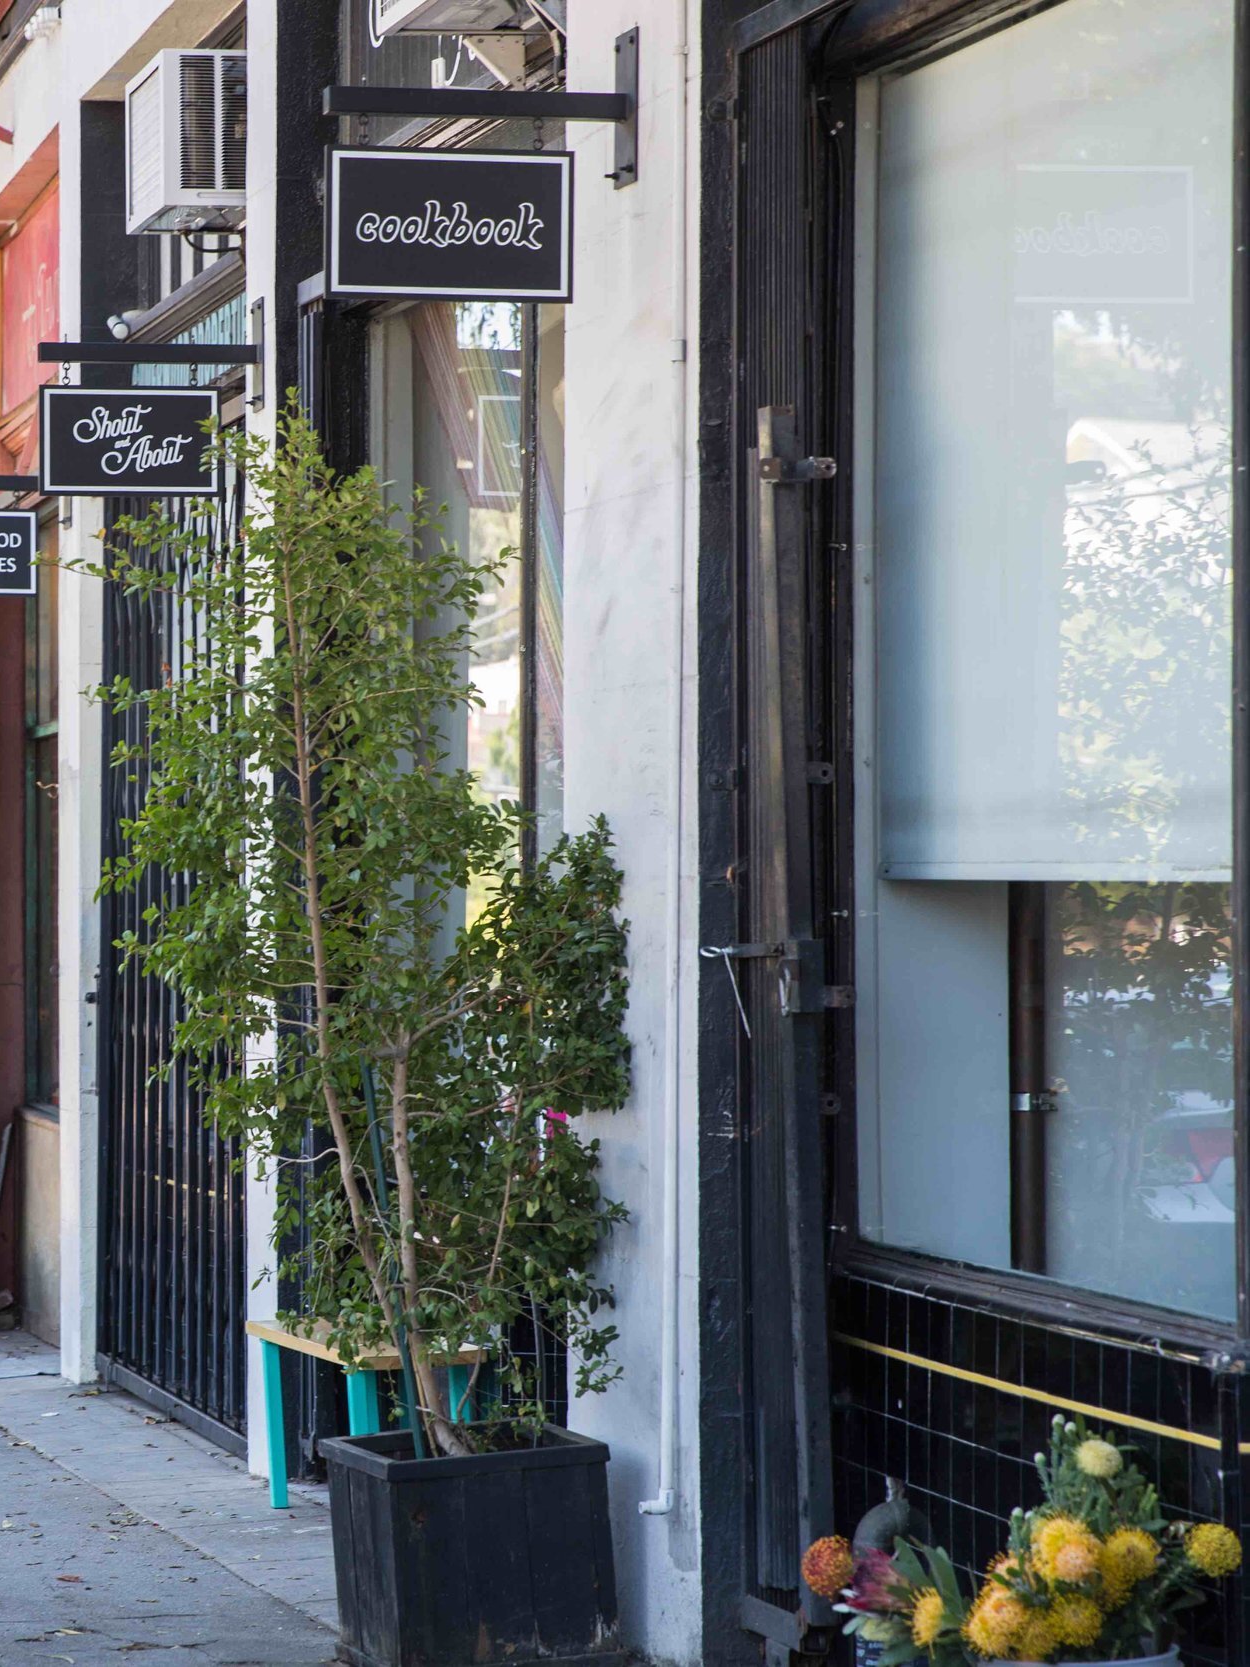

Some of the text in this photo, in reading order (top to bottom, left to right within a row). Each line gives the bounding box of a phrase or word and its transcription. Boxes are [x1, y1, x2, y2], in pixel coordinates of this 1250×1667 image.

[356, 200, 545, 250] cookbook
[72, 404, 152, 443] Shout
[114, 436, 132, 449] and
[101, 434, 193, 475] About
